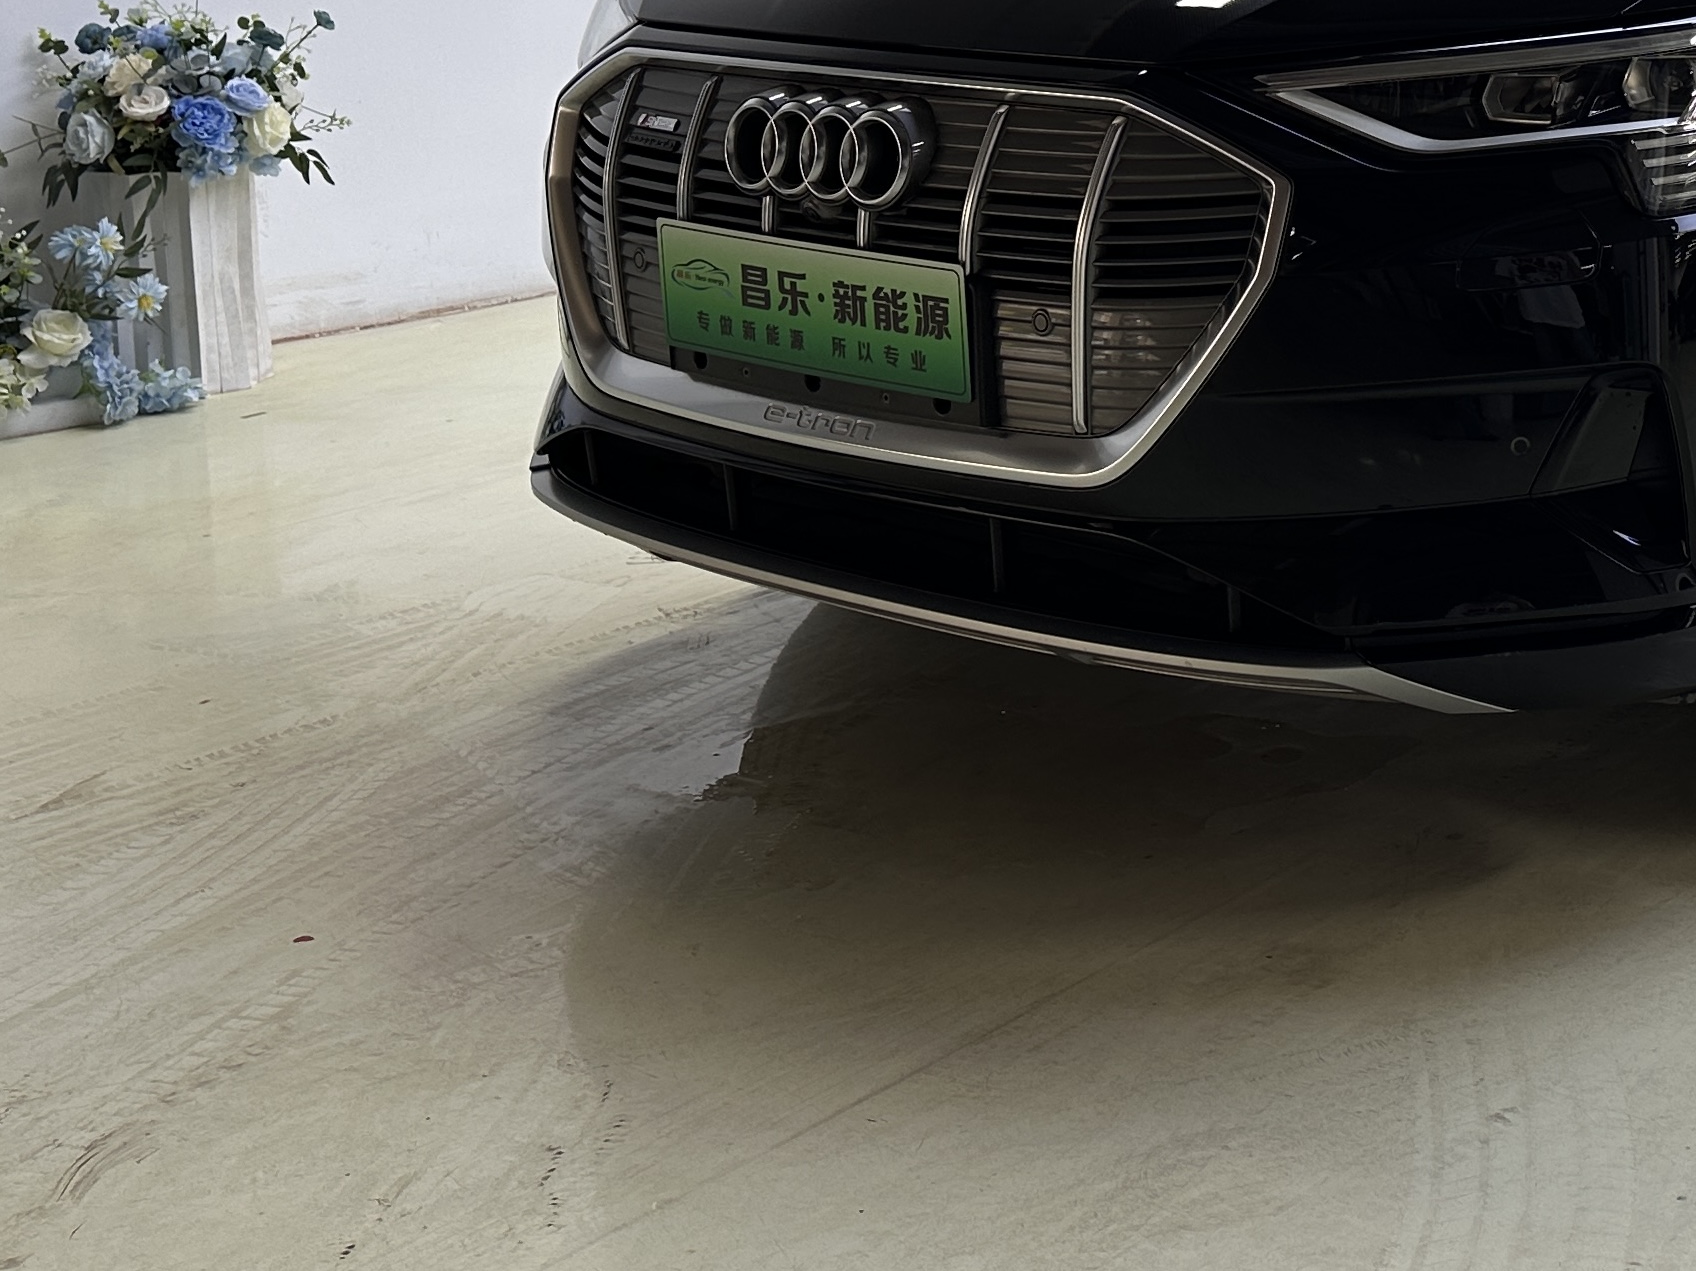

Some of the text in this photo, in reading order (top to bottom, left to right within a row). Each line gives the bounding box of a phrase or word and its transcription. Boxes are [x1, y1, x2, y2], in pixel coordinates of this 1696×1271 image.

[740, 262, 952, 340] 昌乐·新能源
[763, 402, 876, 441] e-tron
